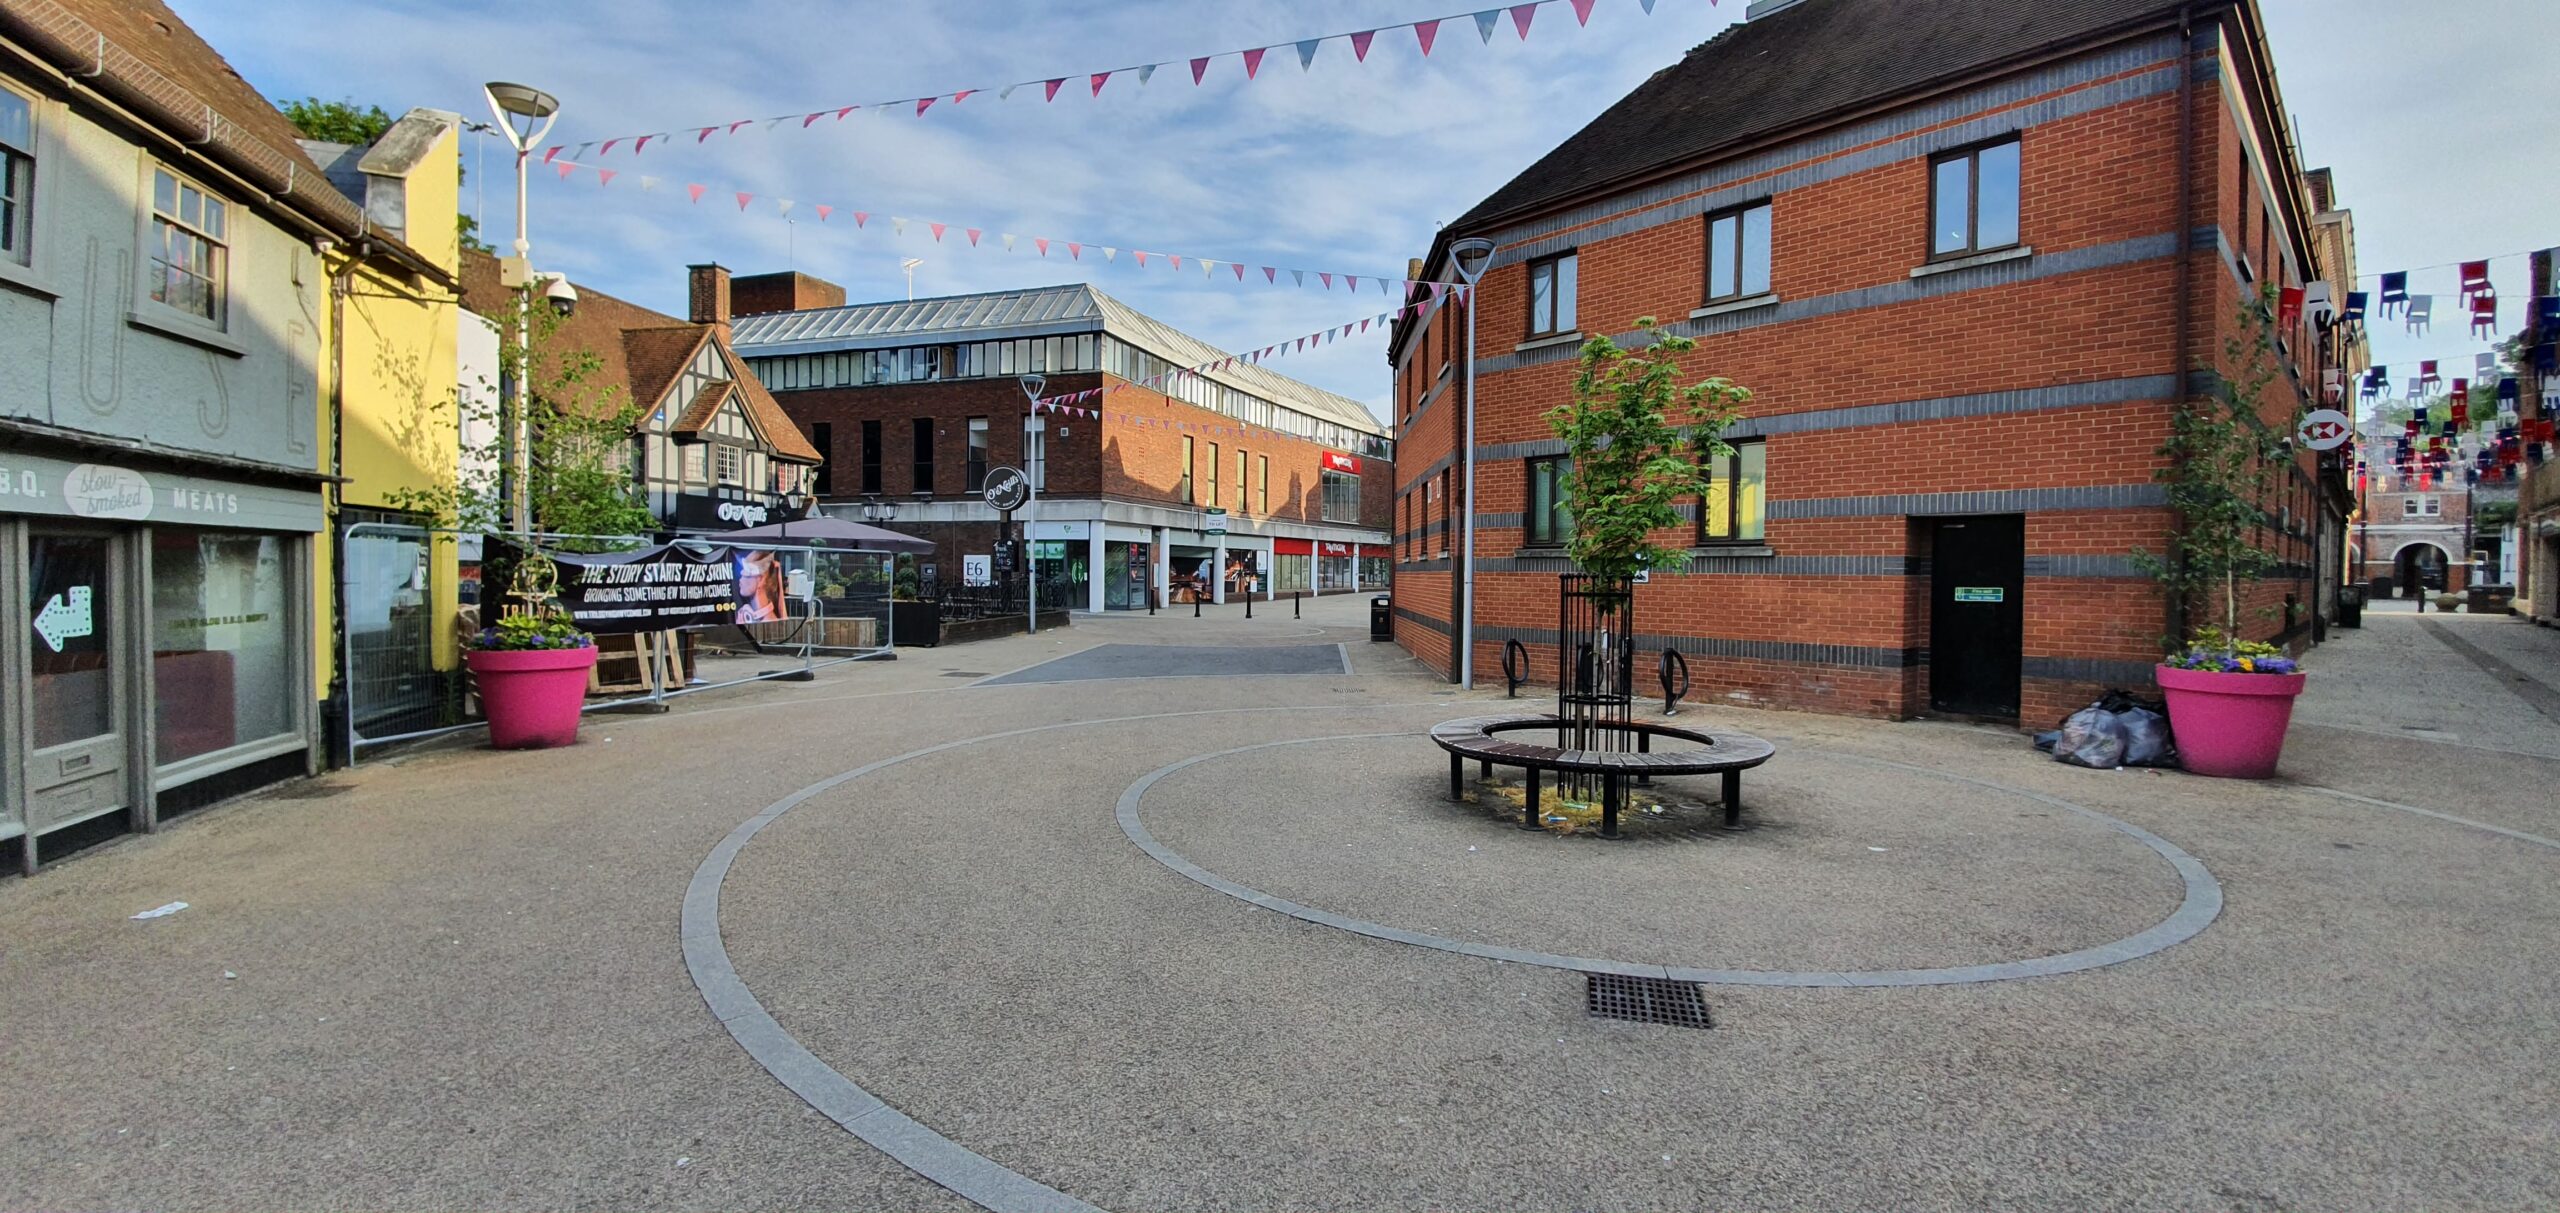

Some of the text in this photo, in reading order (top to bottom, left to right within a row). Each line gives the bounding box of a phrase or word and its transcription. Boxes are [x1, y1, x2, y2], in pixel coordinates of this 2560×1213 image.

[86, 482, 142, 514] smoked
[173, 487, 239, 514] MEATS
[581, 563, 608, 584] THE
[606, 563, 645, 585] STORY
[643, 562, 682, 584] STARTS
[684, 562, 708, 583] THIS
[966, 561, 983, 576] E6
[583, 586, 623, 603] BRINGING
[624, 584, 667, 602] SOMETHING
[679, 585, 688, 600] TO
[687, 584, 703, 600] HIGH
